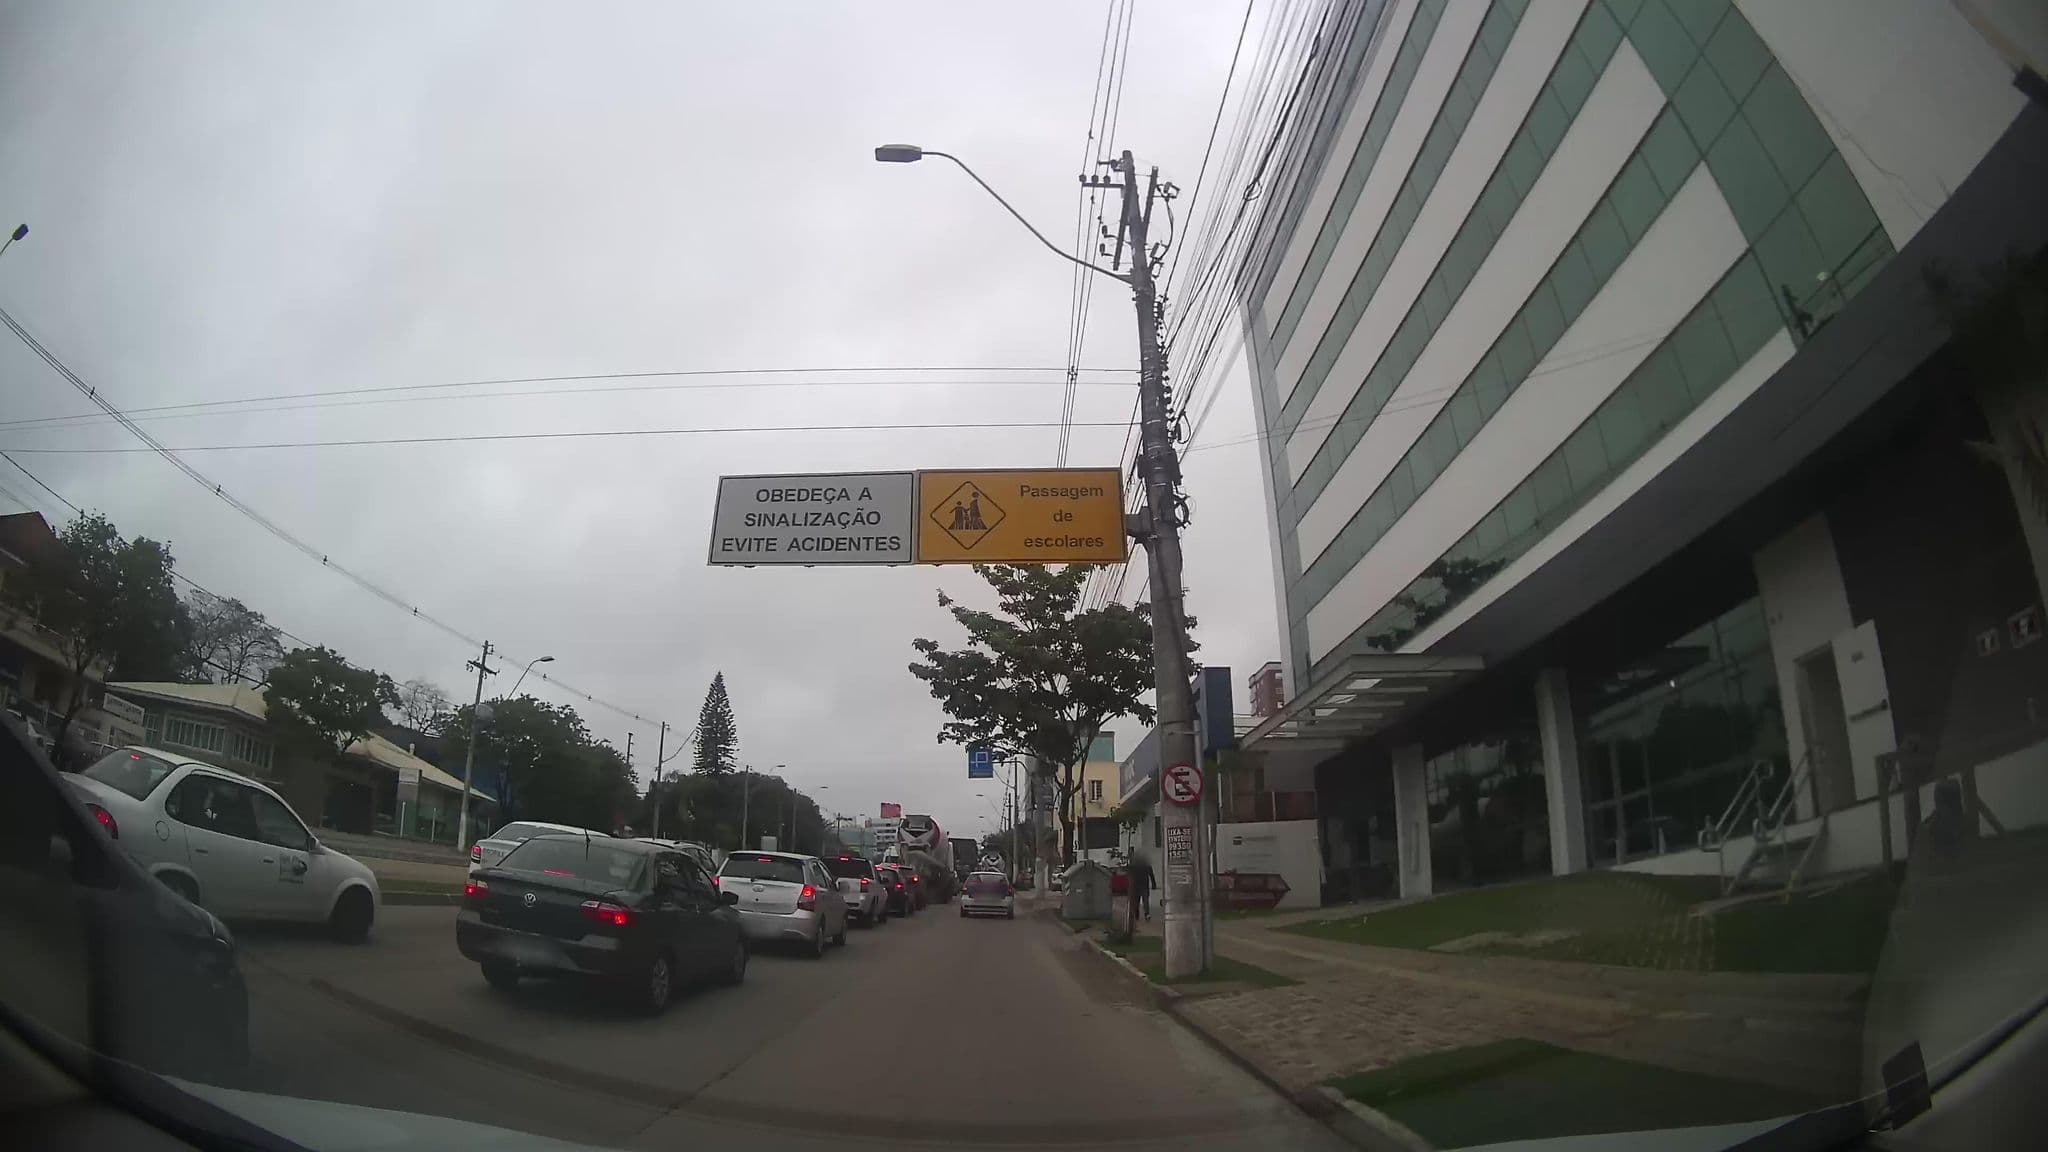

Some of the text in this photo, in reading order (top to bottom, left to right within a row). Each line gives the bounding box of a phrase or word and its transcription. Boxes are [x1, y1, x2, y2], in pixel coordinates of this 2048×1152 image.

[755, 487, 873, 505] OBEDEÇA A
[1020, 485, 1104, 500] Passagem
[744, 507, 882, 529] SINALIZAÇÃO
[1053, 509, 1073, 522] de
[721, 536, 902, 552] EVITE ACIDENTES
[1023, 534, 1105, 548] escolares
